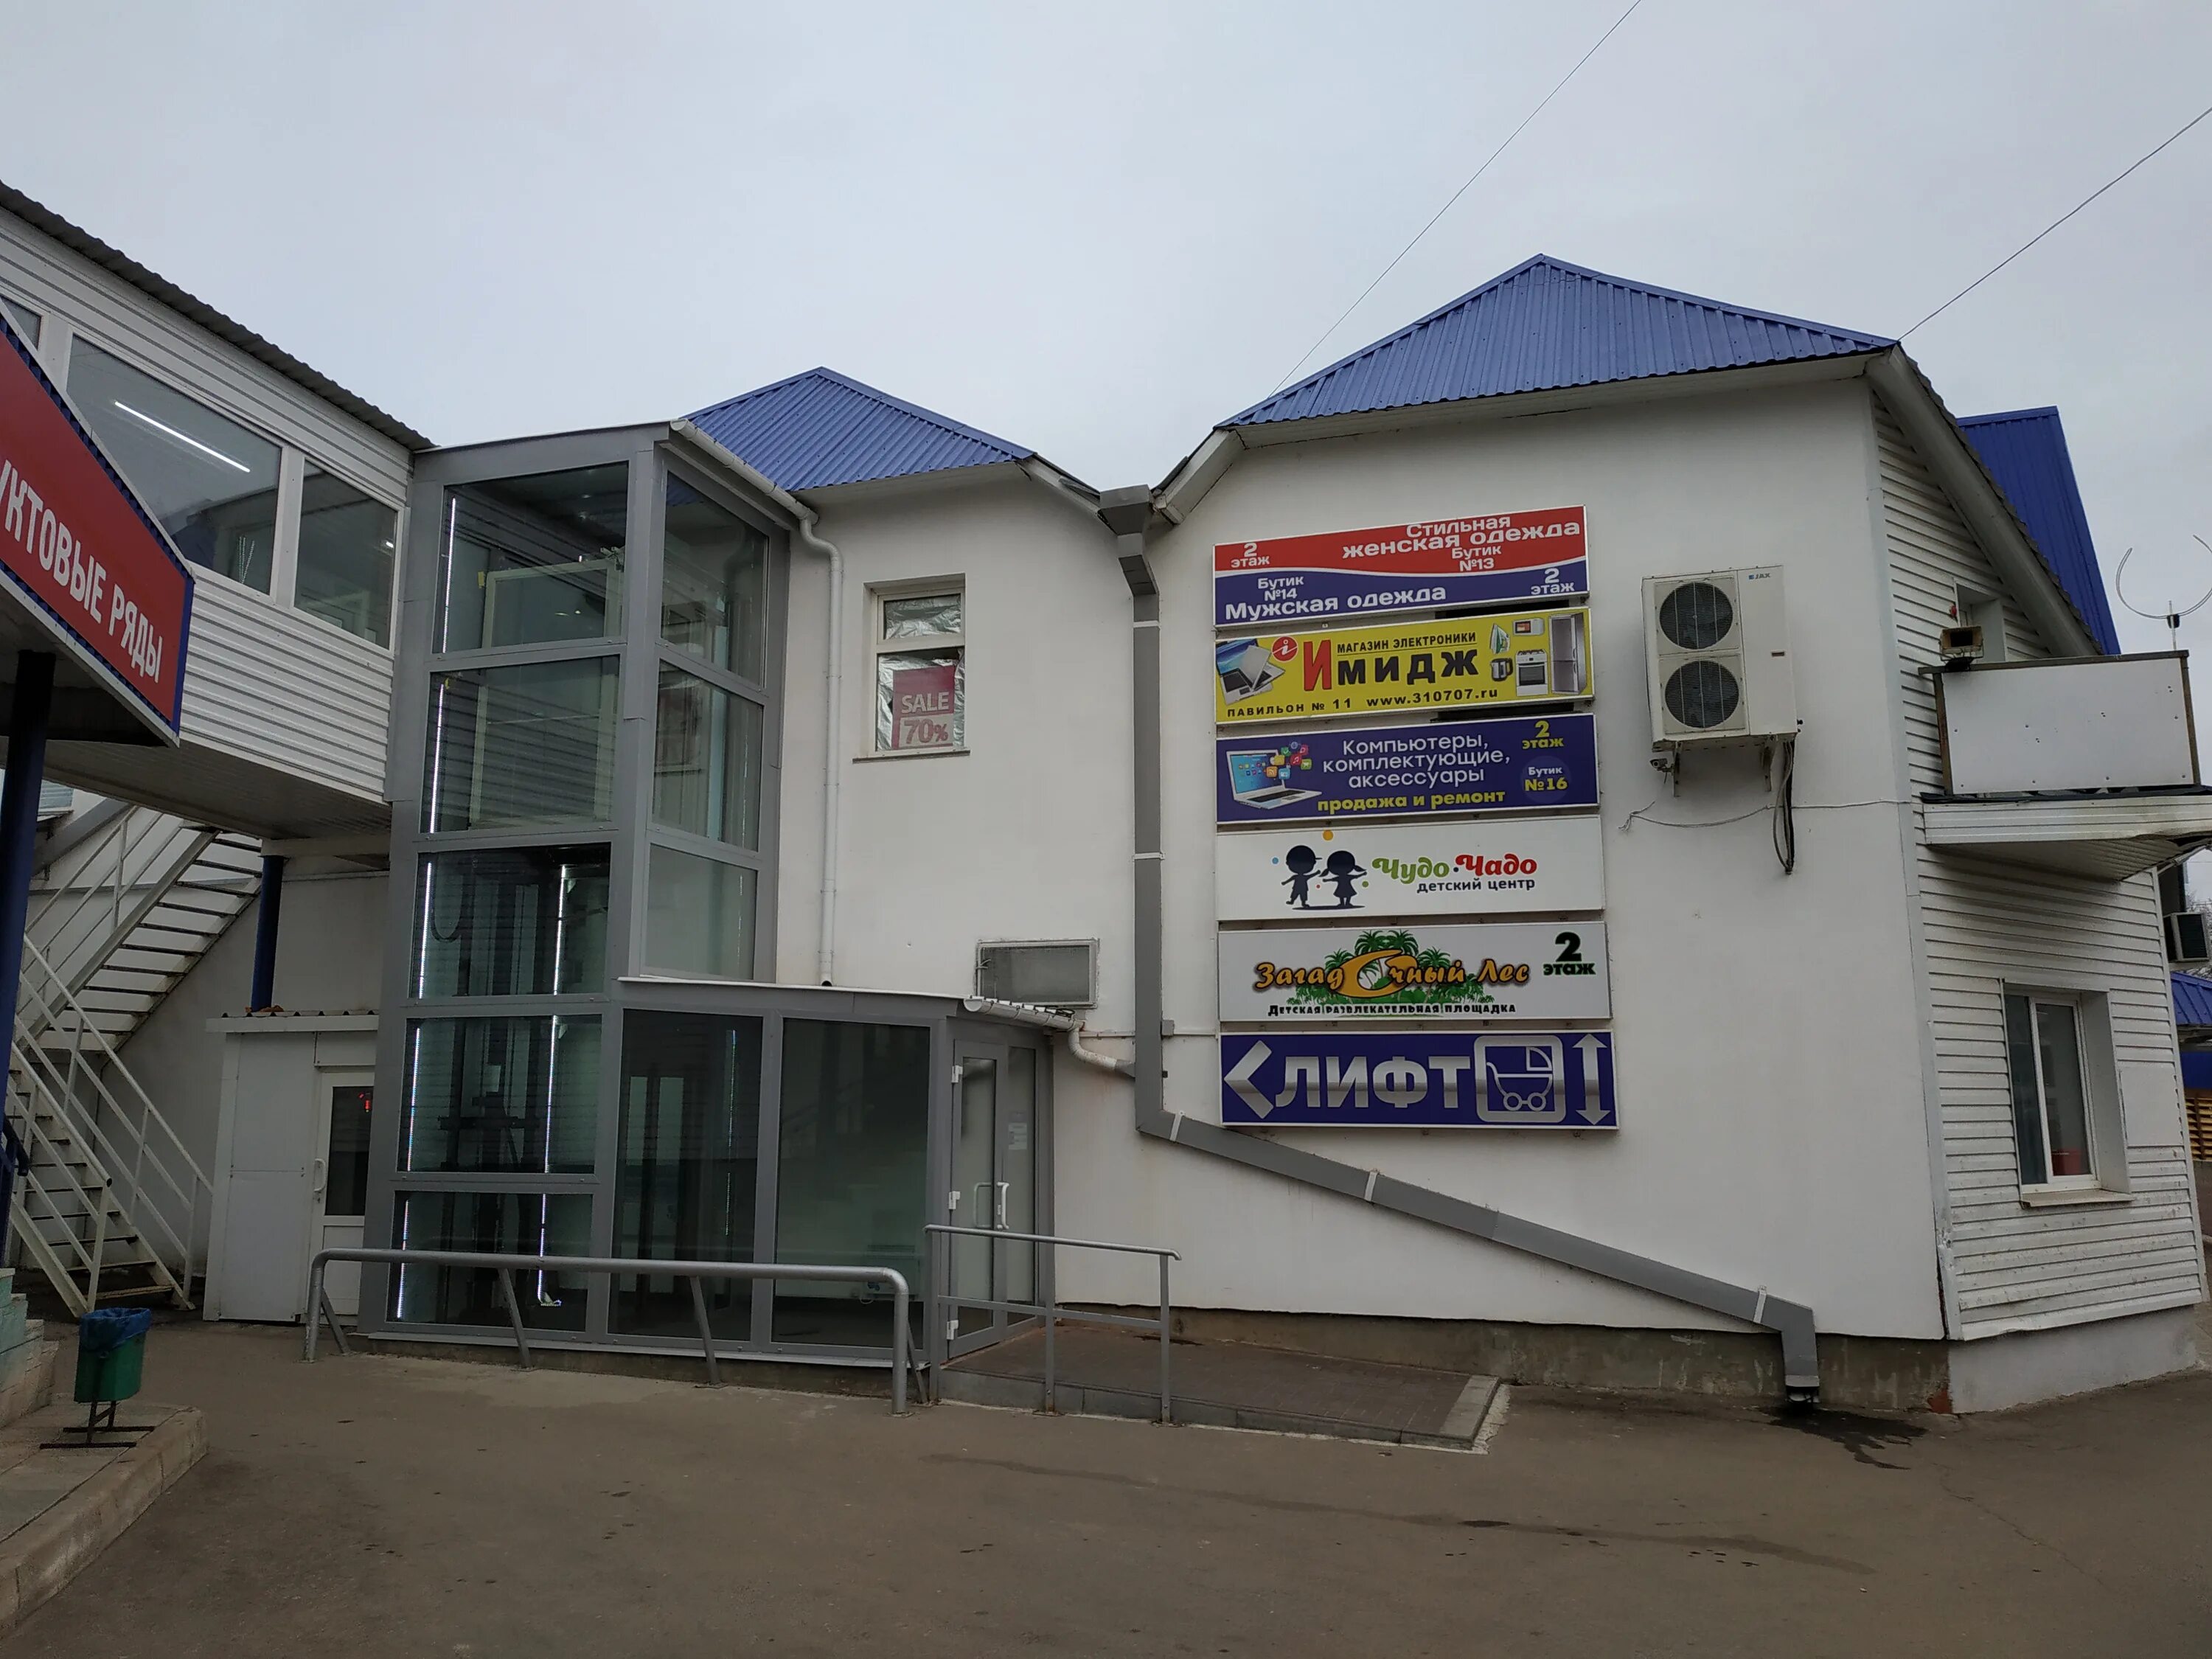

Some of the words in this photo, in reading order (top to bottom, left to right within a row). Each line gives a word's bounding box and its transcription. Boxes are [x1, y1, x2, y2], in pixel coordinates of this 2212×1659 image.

[1406, 516, 1512, 538] Стильная
[1243, 543, 1258, 558] 2
[1342, 535, 1461, 560] женская
[1470, 521, 1580, 544] одежда
[1231, 554, 1270, 568] этаж
[1451, 544, 1502, 560] Бутик
[1458, 557, 1495, 572] №13
[1257, 575, 1304, 591] Бутик
[1543, 568, 1560, 585] 2
[1264, 588, 1298, 601] №14
[1530, 580, 1575, 596] этаж
[1225, 598, 1339, 621] Мужская
[1346, 587, 1447, 611] одежда
[108, 582, 163, 684] РЯДЫ
[1337, 639, 1390, 654] МАГАЗИН
[1392, 632, 1476, 649] ЭЛЕКТРОНИКИ
[901, 692, 950, 714] SALE
[1227, 703, 1305, 717] ПАВИЛЬОН
[1332, 698, 1352, 709] 11
[1366, 687, 1498, 708] www.310707.ru
[903, 718, 950, 745] 70%
[1534, 720, 1550, 737] 2
[1342, 734, 1489, 757] Компьютеры,
[1522, 736, 1564, 750] этаж
[1322, 748, 1512, 773] комплектующие,
[1348, 768, 1484, 790] аксессуары
[1528, 765, 1562, 777] Бутик
[1524, 776, 1568, 791] №16
[1316, 793, 1408, 815] продажа
[1413, 795, 1425, 806] и
[1430, 790, 1506, 810] ремонт
[1416, 877, 1482, 894] детский
[1486, 877, 1535, 892] центр
[1554, 931, 1583, 962] 2
[1477, 959, 1529, 984] Лес
[1543, 961, 1596, 977] этаж
[1275, 1056, 1471, 1109] ЛИФТ
